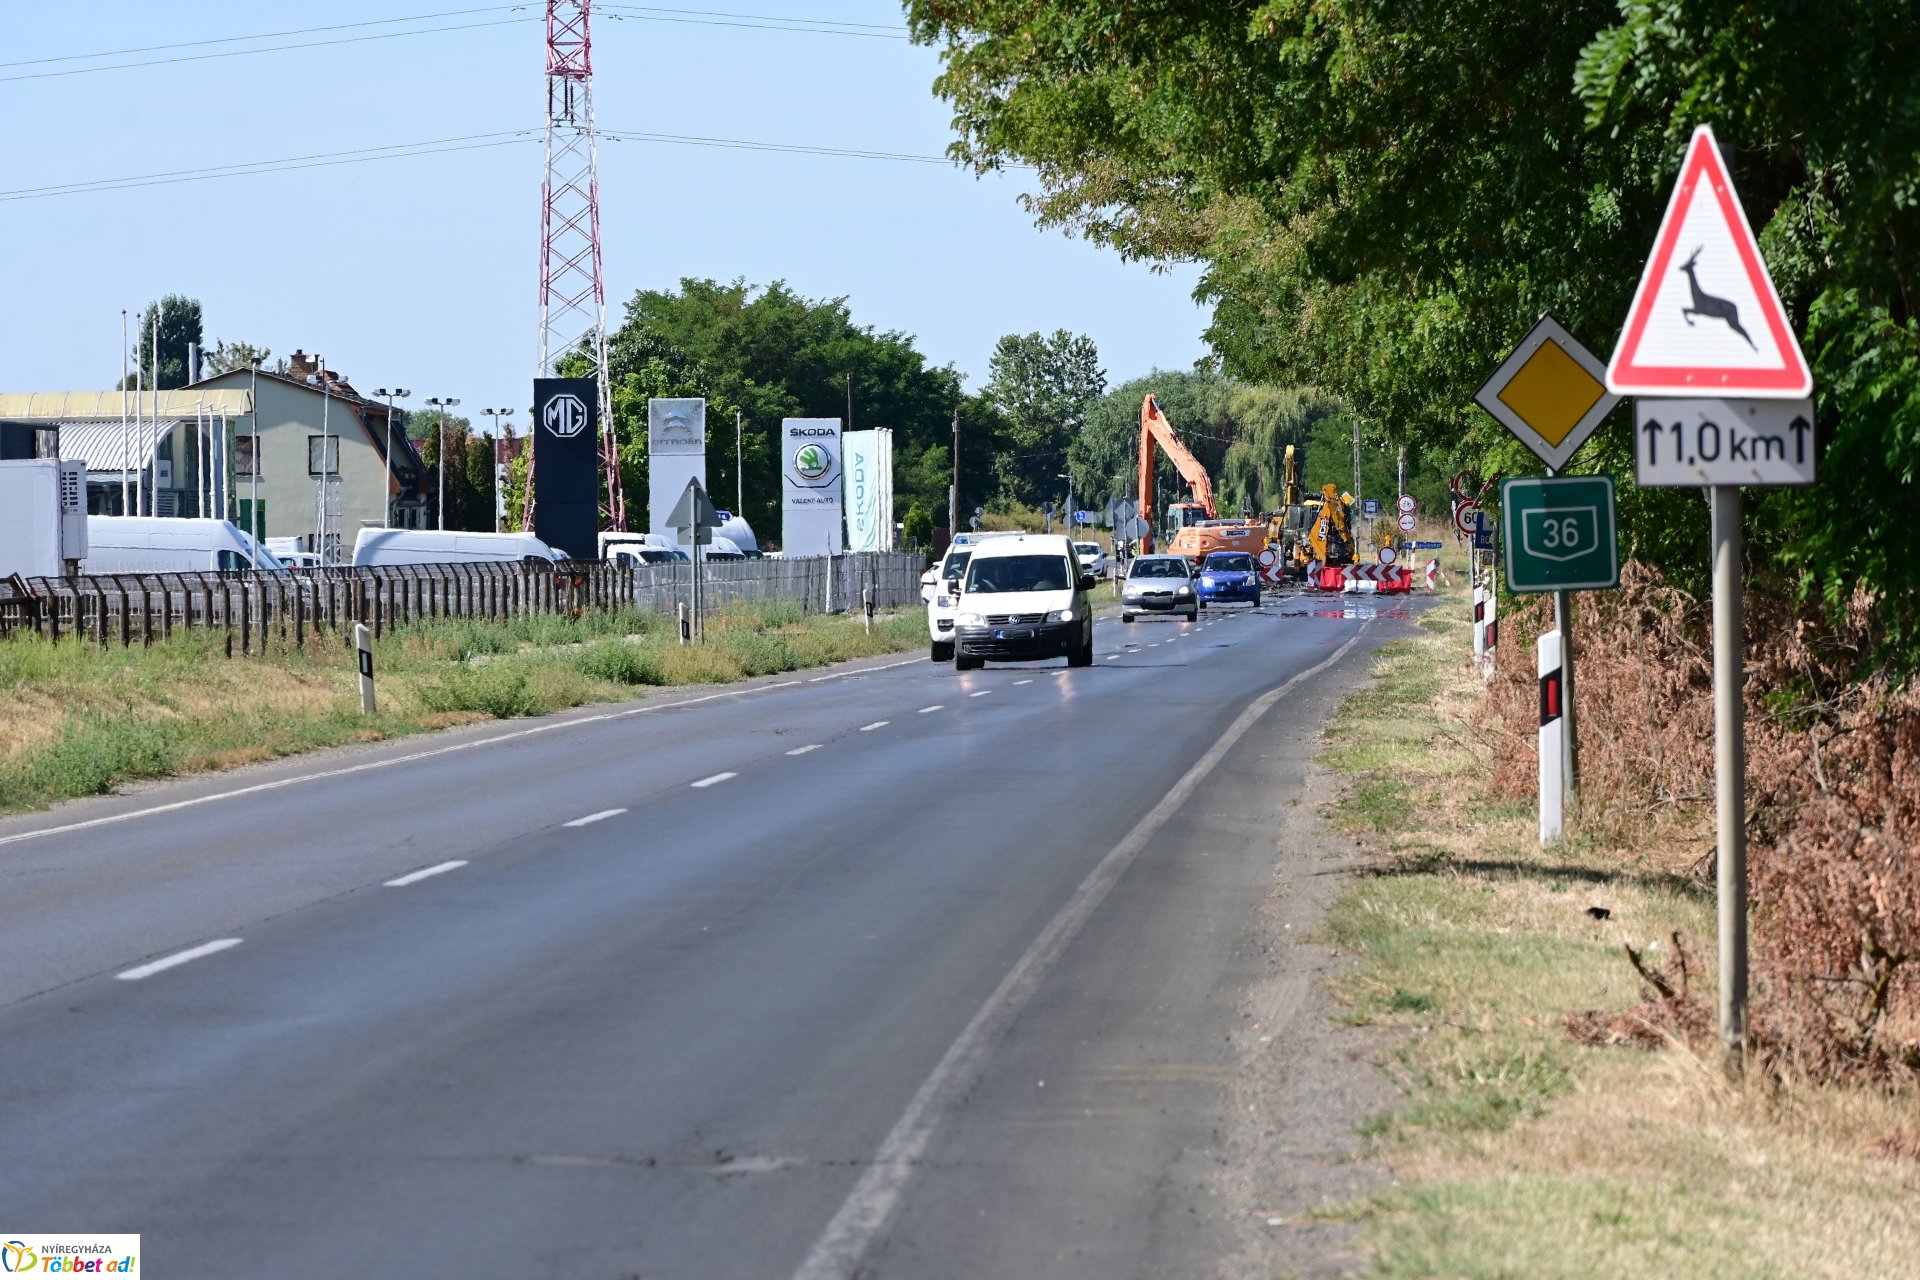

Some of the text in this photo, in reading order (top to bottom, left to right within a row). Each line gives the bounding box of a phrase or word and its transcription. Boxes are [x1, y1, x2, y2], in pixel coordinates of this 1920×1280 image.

[549, 398, 583, 434] MG
[789, 427, 835, 437] ŠKODA
[1729, 427, 1785, 462] km
[1318, 518, 1328, 541] JCB
[1542, 518, 1579, 548] 36
